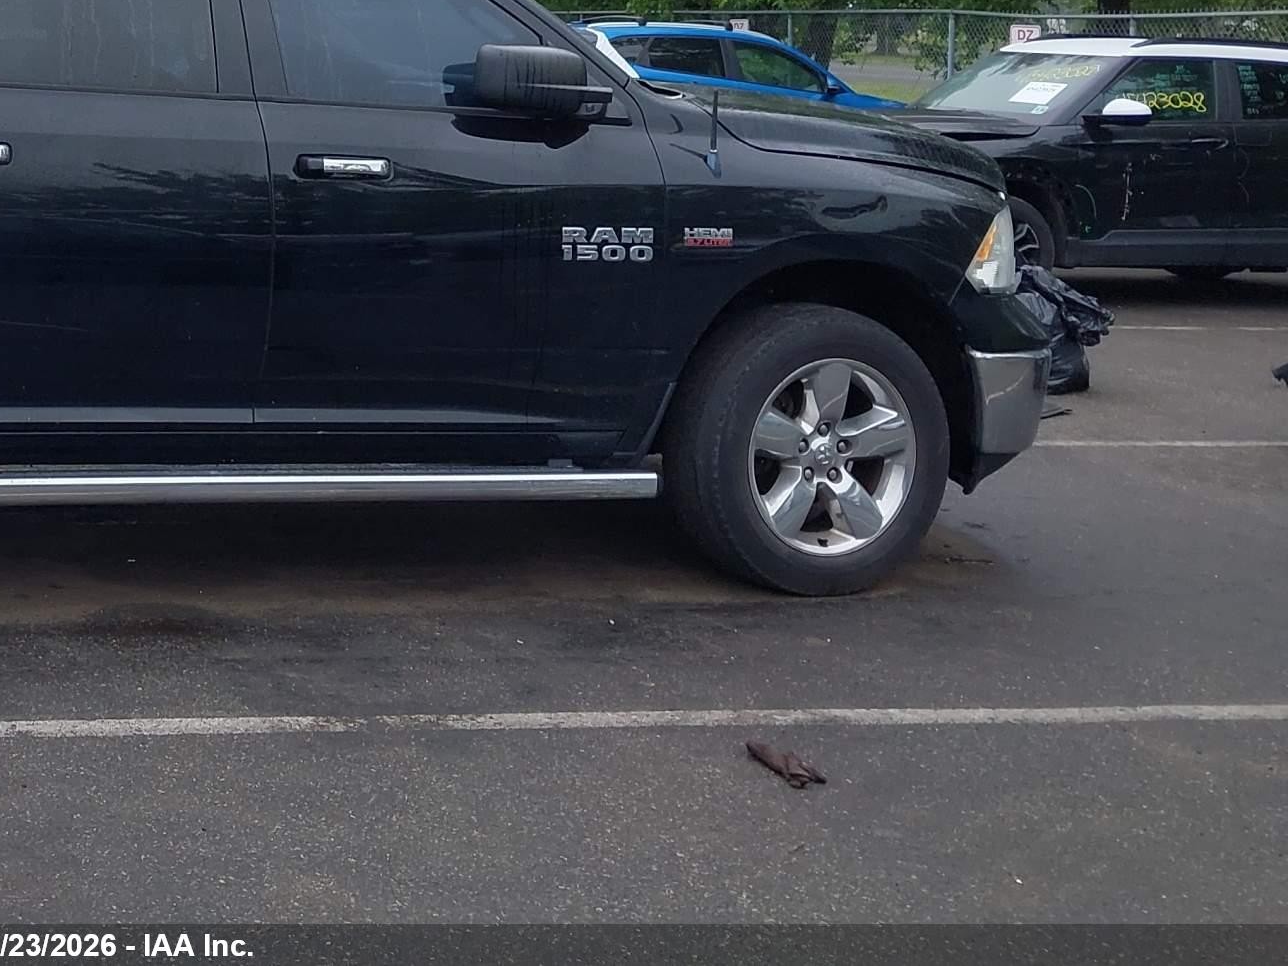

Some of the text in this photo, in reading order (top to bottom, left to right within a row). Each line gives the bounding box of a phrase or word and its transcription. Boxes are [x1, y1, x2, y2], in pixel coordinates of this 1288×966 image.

[562, 227, 654, 244] RAM
[684, 227, 733, 238] HEMI
[562, 244, 654, 262] 1500
